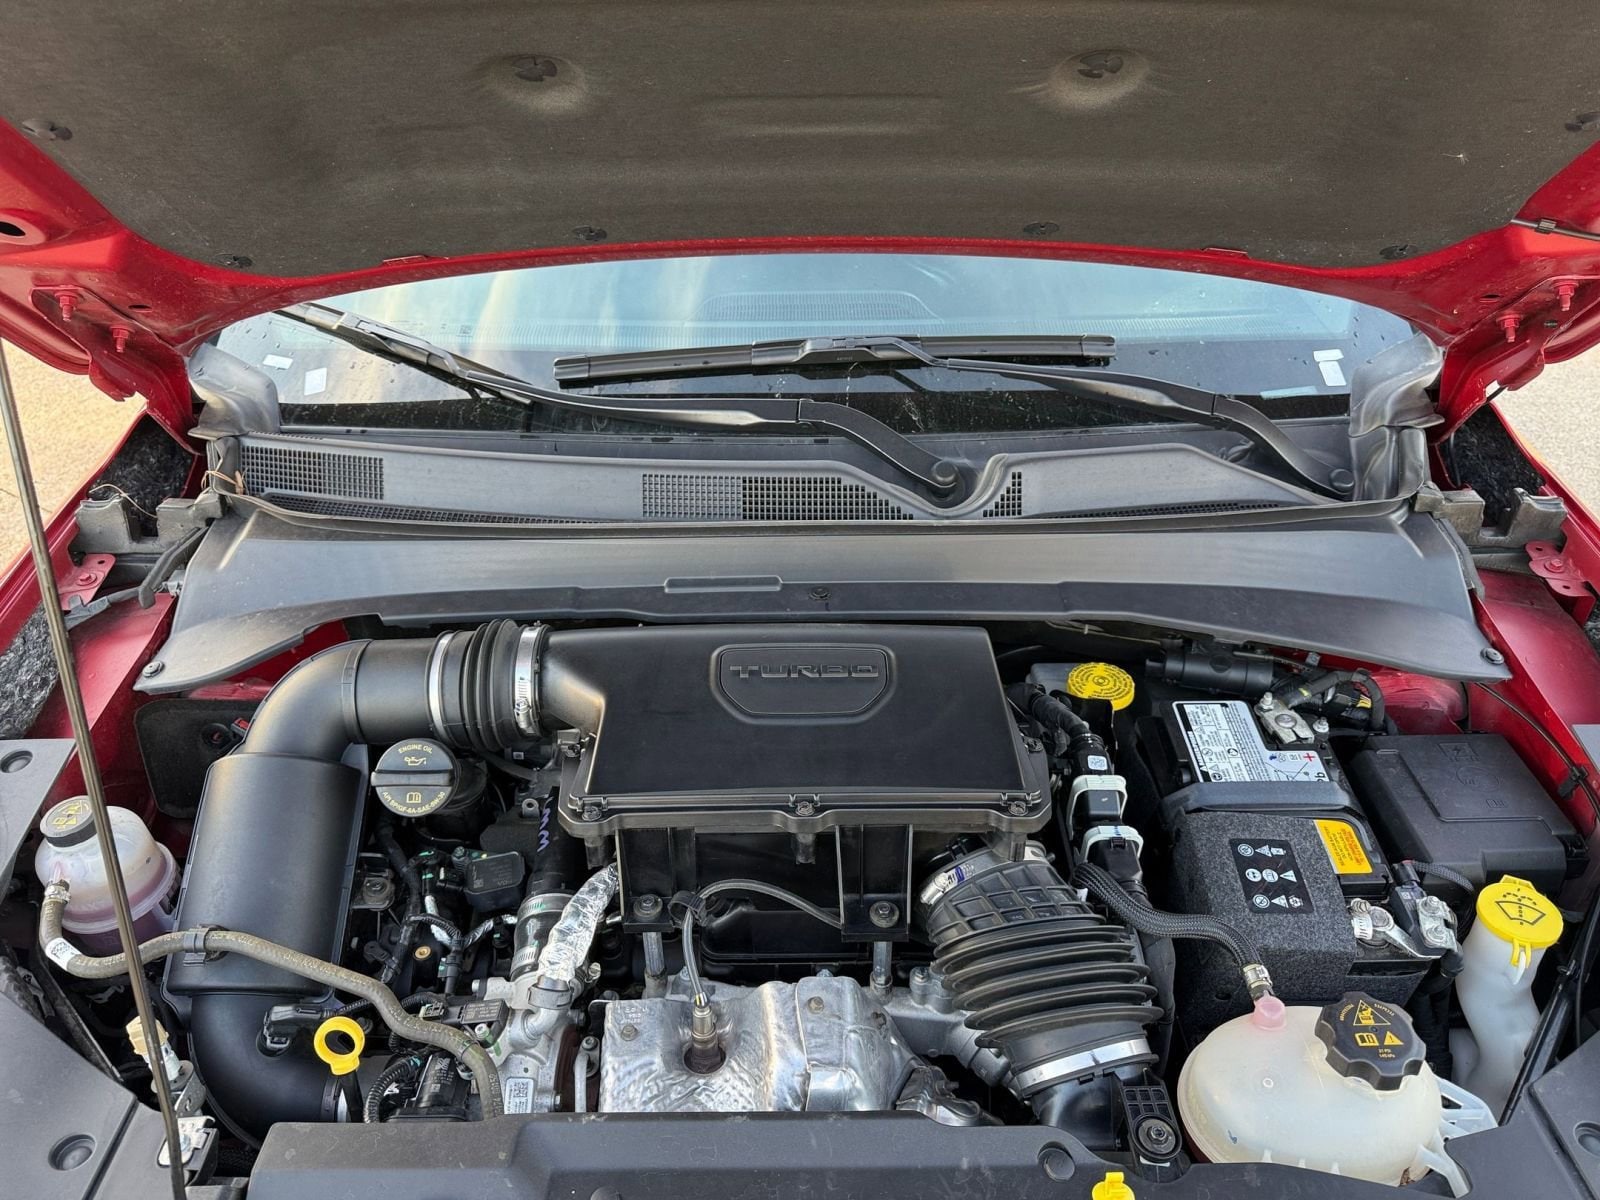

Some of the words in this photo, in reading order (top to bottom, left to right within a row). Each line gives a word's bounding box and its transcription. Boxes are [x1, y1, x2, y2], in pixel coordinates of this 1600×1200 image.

[729, 664, 879, 679] TURBO
[397, 744, 422, 754] ENGINE
[423, 745, 433, 754] OIL
